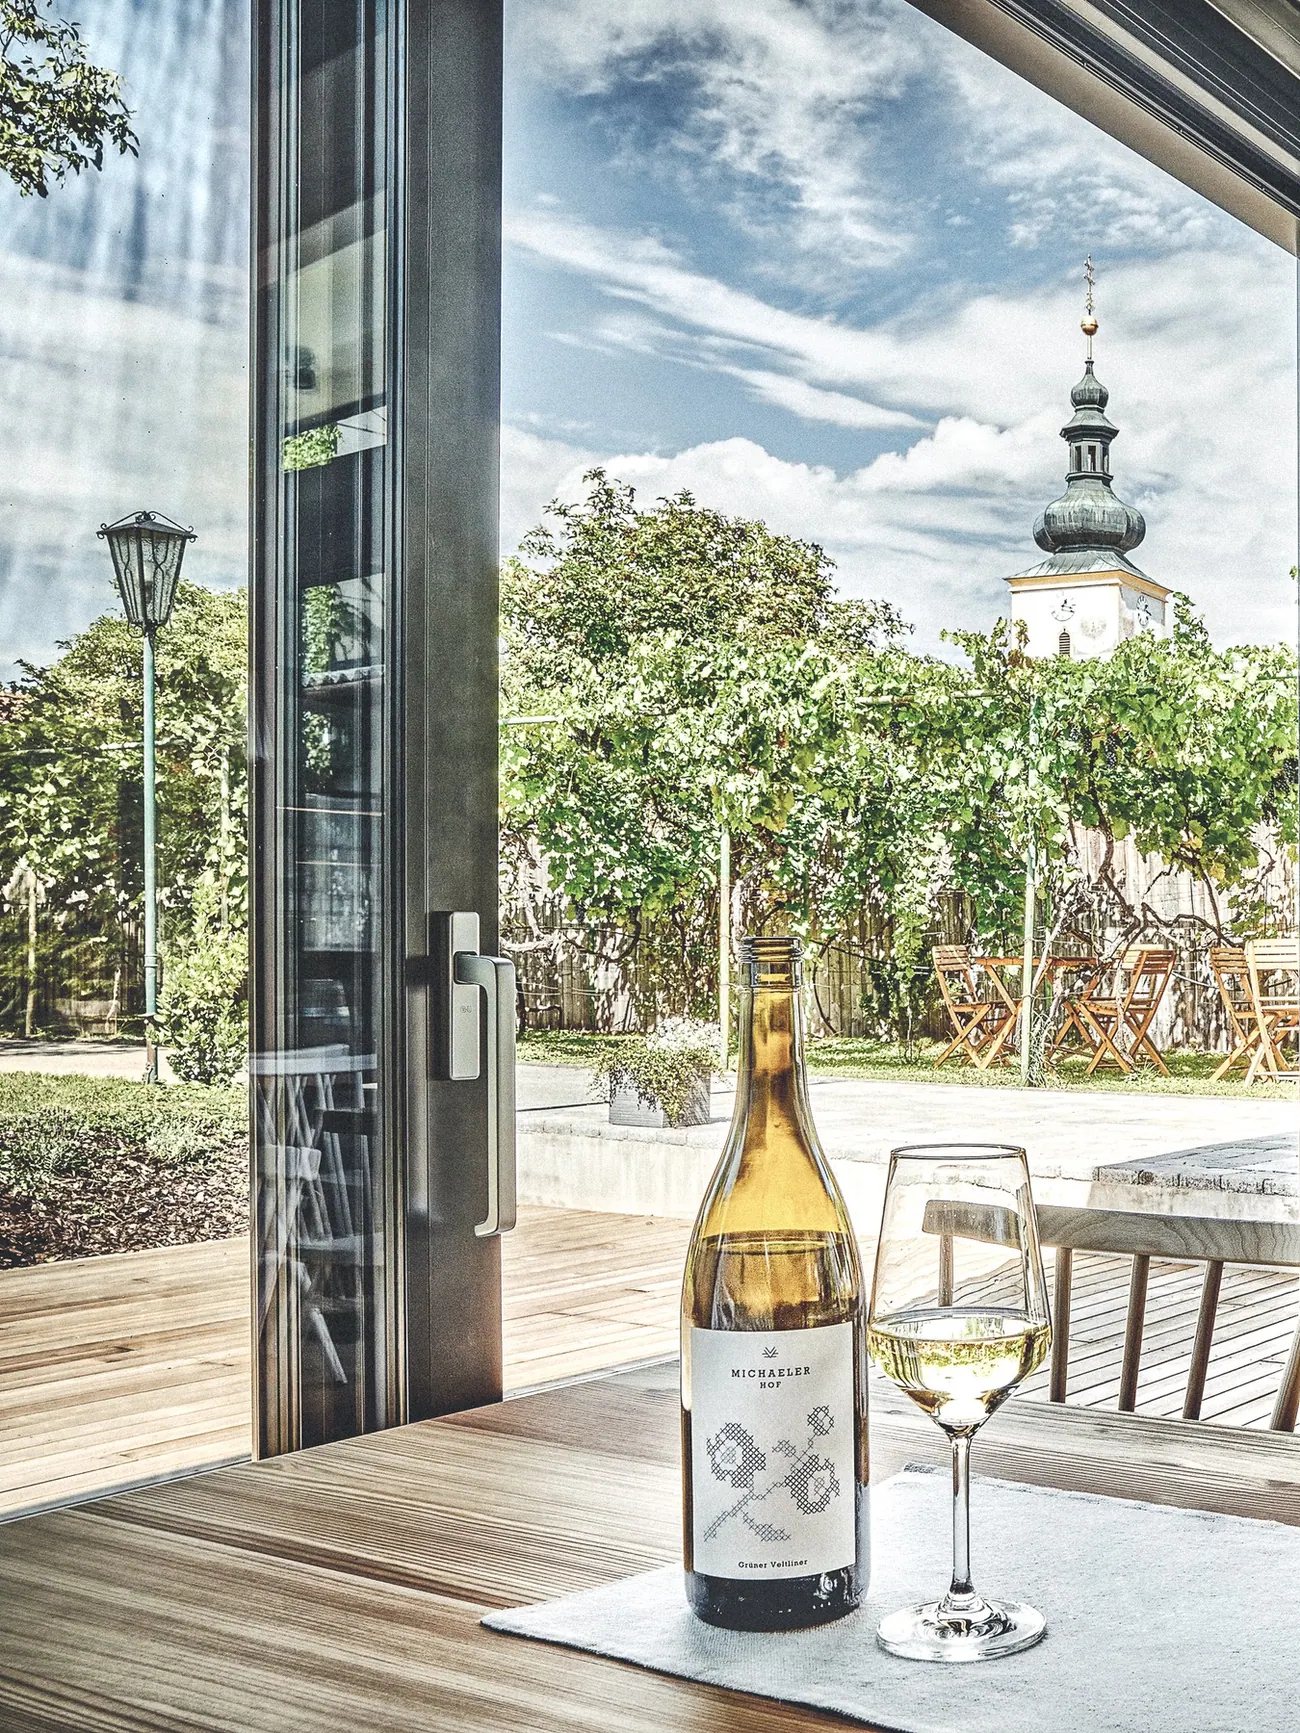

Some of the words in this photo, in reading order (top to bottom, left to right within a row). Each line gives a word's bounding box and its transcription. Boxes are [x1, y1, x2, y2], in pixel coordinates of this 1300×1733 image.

[731, 1366, 811, 1378] MICHAELER
[760, 1381, 781, 1389] HOF
[738, 1561, 767, 1569] Grüner
[770, 1560, 808, 1568] Veltliner
